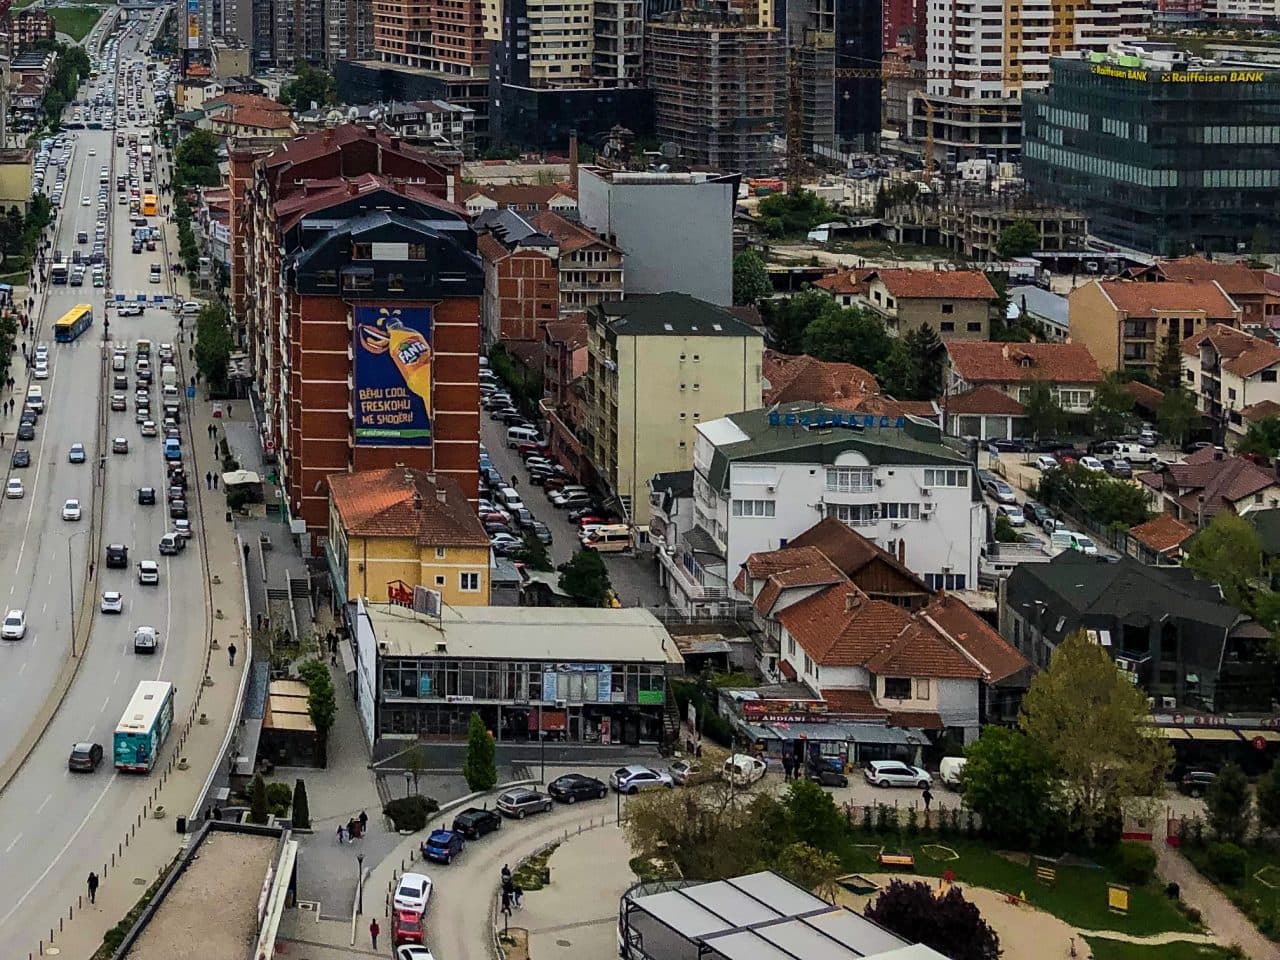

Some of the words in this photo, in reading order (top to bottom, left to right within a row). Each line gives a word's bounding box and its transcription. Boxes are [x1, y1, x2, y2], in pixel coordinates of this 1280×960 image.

[1096, 65, 1127, 79] Raiffeisen
[1127, 69, 1148, 82] BANK
[1172, 71, 1227, 83] Raiffeisen
[1229, 71, 1264, 82] BANK
[361, 399, 411, 414] FRESKOHU
